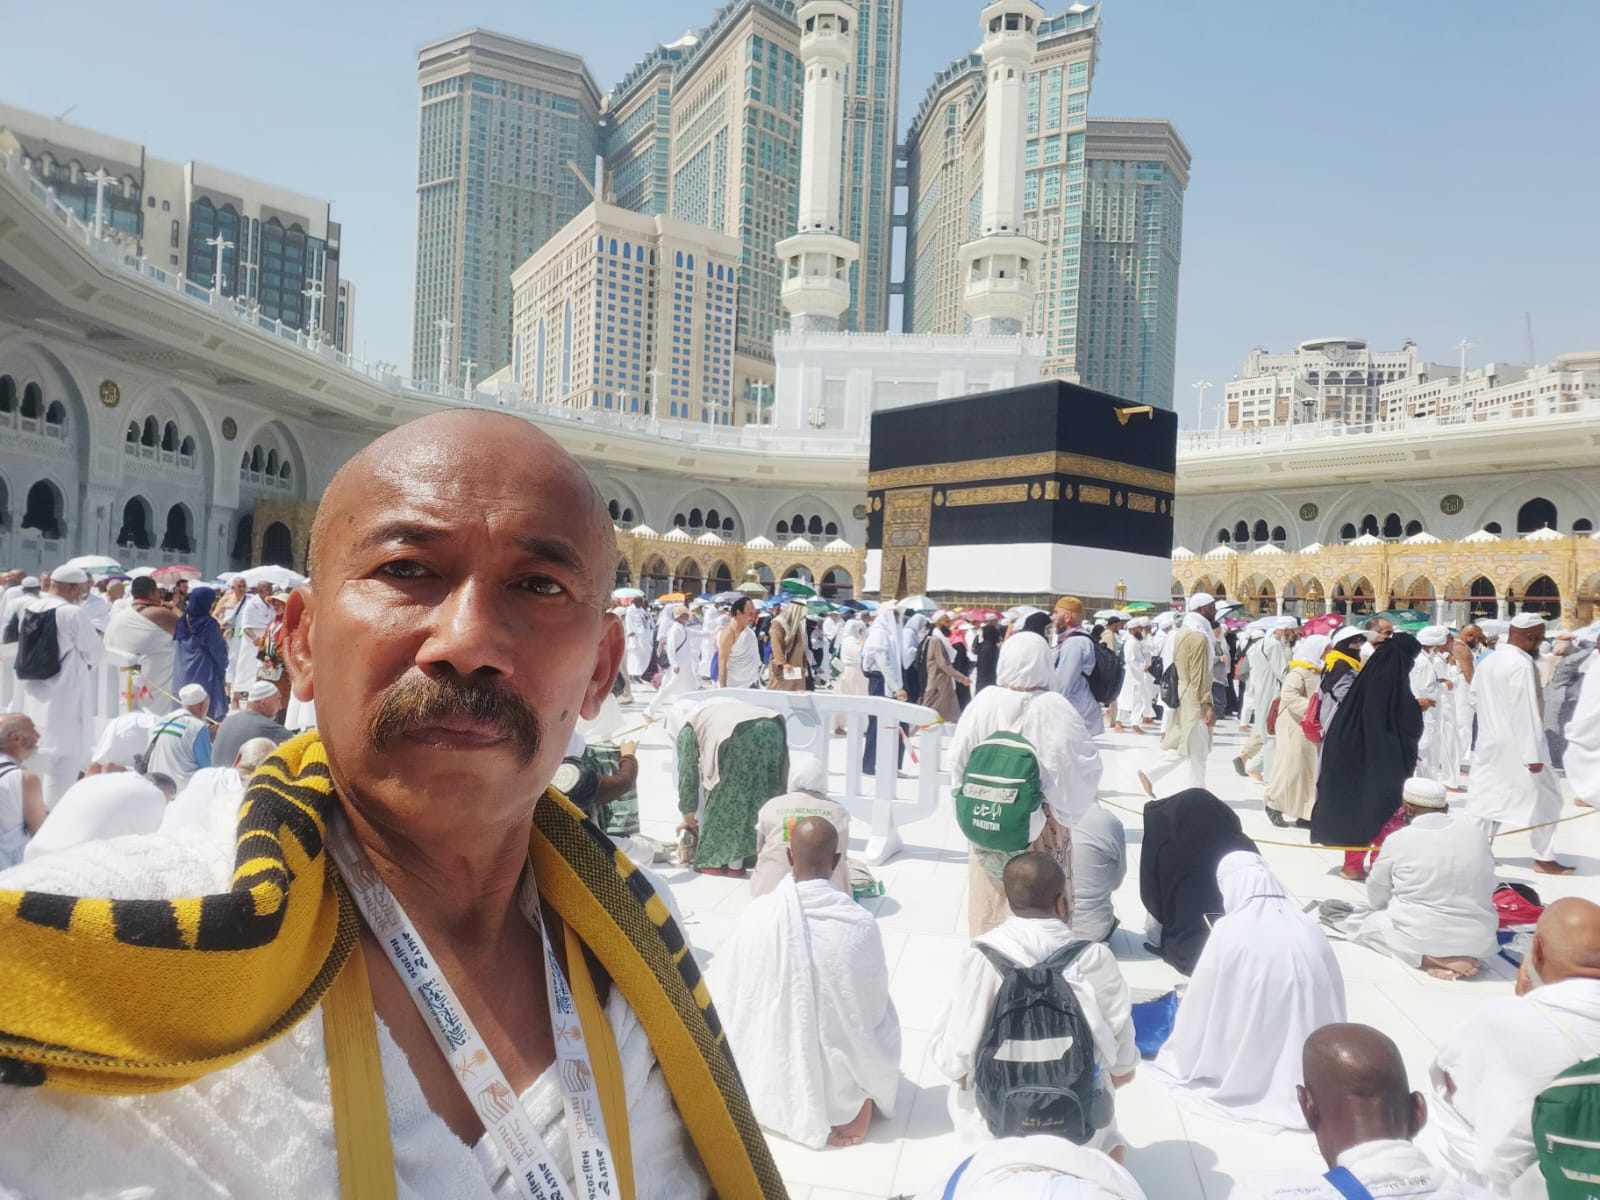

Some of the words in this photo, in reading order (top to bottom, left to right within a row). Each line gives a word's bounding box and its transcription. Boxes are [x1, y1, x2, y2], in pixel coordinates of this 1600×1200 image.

[972, 818, 1000, 831] PAKISTAN
[389, 938, 404, 958] Hajj
[401, 957, 418, 979] 2026
[570, 1096, 585, 1140] nusuk
[498, 1126, 525, 1167] nusuk
[580, 1150, 593, 1173] Hajj
[526, 1171, 542, 1194] Hajj
[585, 1174, 597, 1200] 2026
